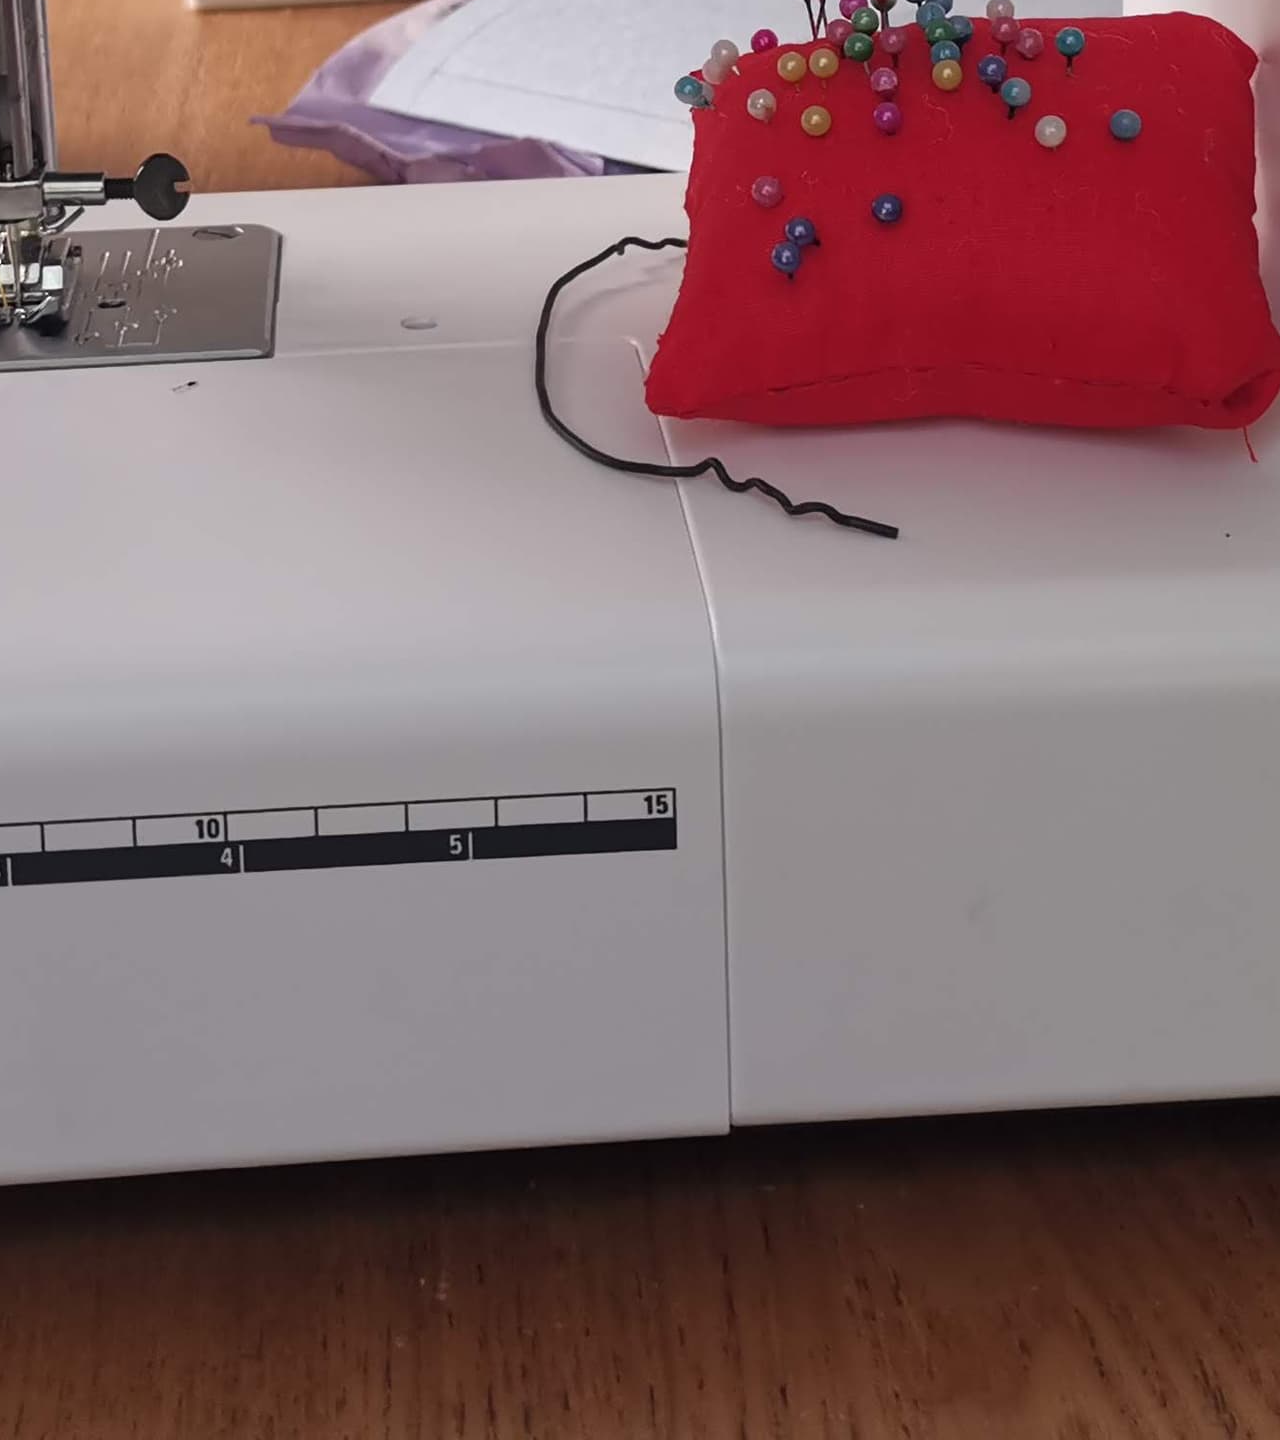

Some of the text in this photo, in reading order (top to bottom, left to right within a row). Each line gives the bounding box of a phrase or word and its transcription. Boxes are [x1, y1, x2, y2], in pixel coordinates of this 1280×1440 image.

[195, 817, 220, 840] 10
[643, 794, 669, 816] 15
[219, 846, 234, 868] 4
[449, 833, 463, 856] 5
